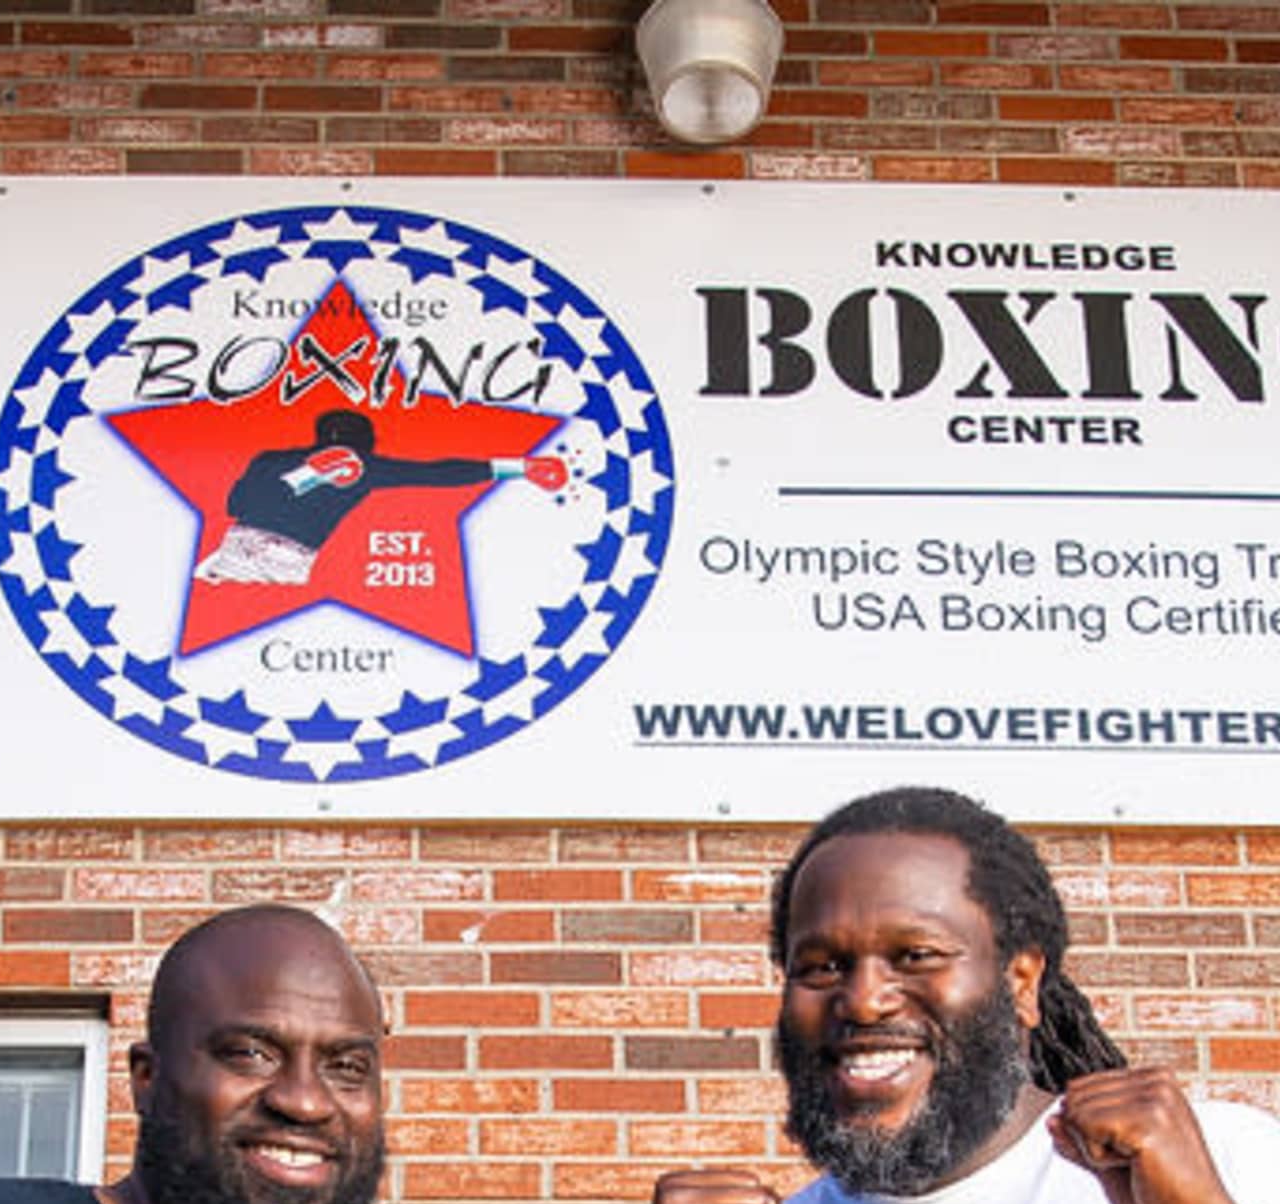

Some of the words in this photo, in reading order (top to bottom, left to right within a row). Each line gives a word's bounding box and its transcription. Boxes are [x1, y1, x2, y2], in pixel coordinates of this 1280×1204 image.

[875, 240, 1177, 273] KNOWLEDGE
[231, 289, 449, 322] Knowledge
[126, 335, 559, 407] BOXING
[947, 415, 1144, 446] CENTER
[368, 531, 432, 557] EST.
[365, 562, 436, 588] 2013
[699, 535, 901, 583] Olympic
[916, 538, 1037, 584] Style
[1055, 540, 1221, 590] Boxing
[812, 592, 925, 632] USA
[939, 595, 1108, 644] Boxing
[259, 639, 394, 674] Center
